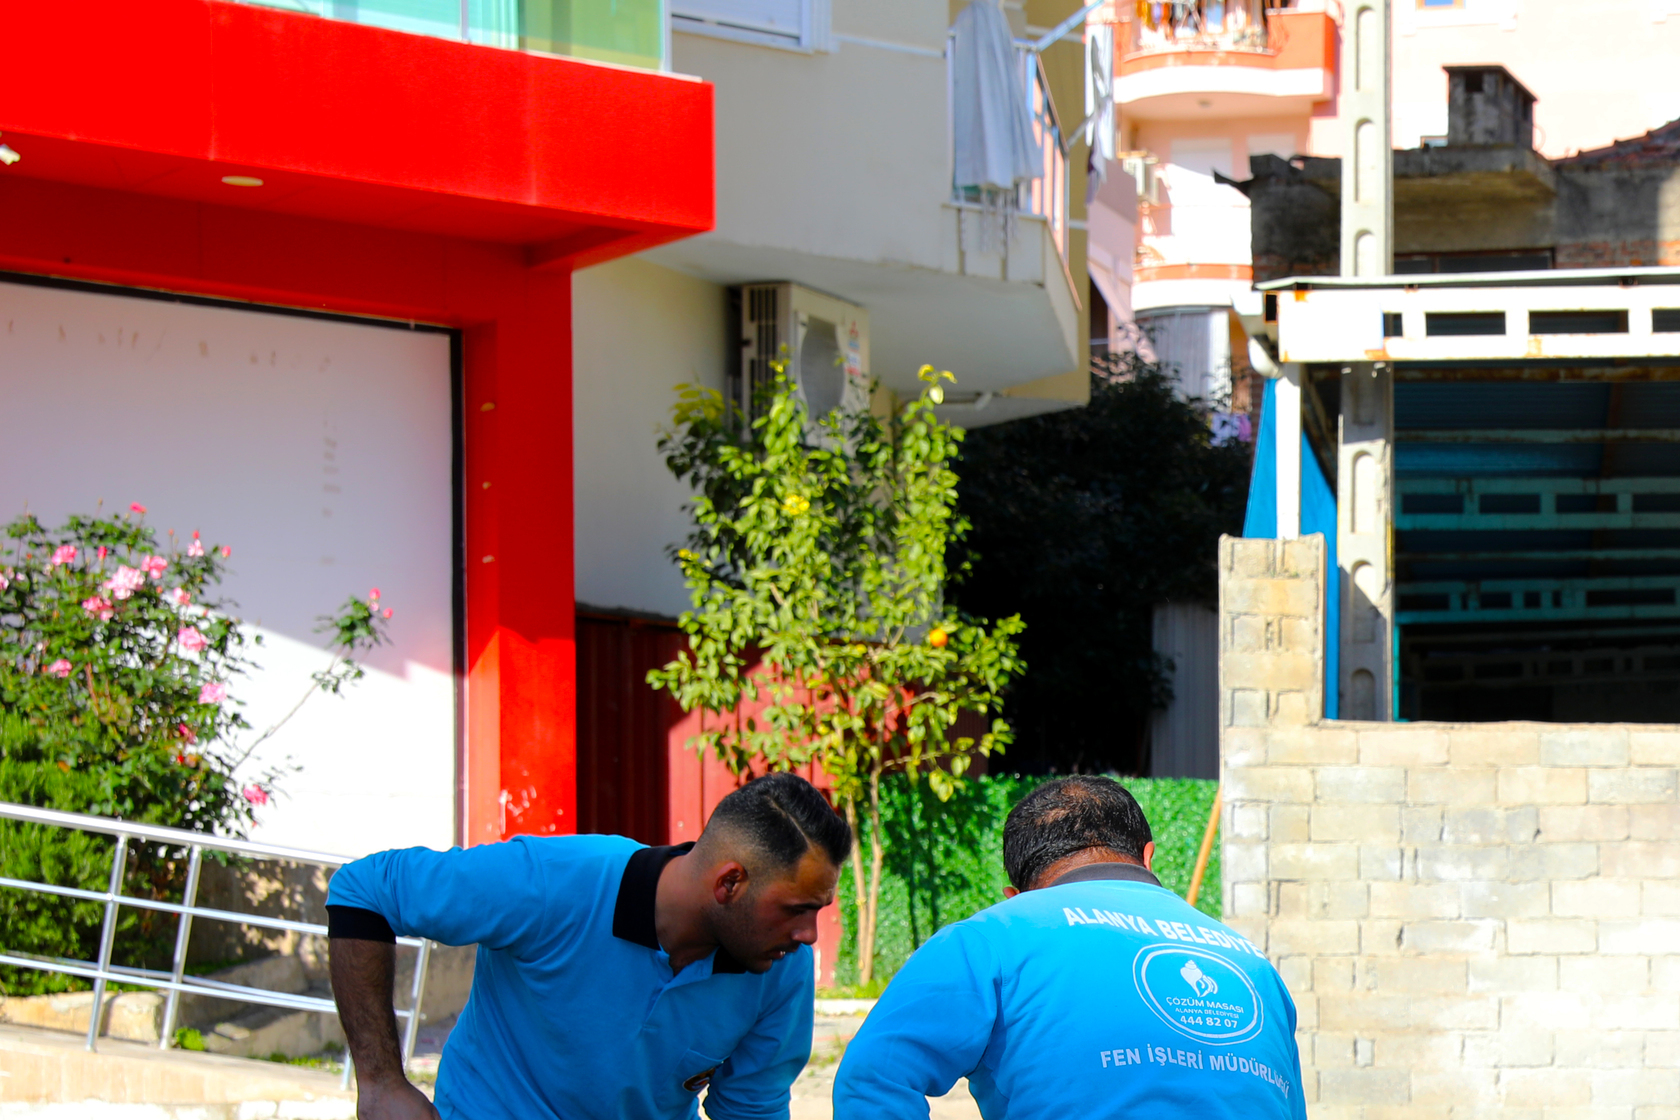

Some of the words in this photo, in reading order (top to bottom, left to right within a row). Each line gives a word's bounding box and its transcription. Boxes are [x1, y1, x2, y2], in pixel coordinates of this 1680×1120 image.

[1062, 907, 1158, 937] ALANYA
[1165, 996, 1205, 1007] ÇÖZÜM
[1206, 1000, 1244, 1014] MASASI
[1180, 1015, 1203, 1025] 444
[1205, 1016, 1222, 1027] 82
[1223, 1018, 1238, 1029] 07
[1100, 1047, 1142, 1069] FEN
[1146, 1043, 1205, 1070] İŞLERİ
